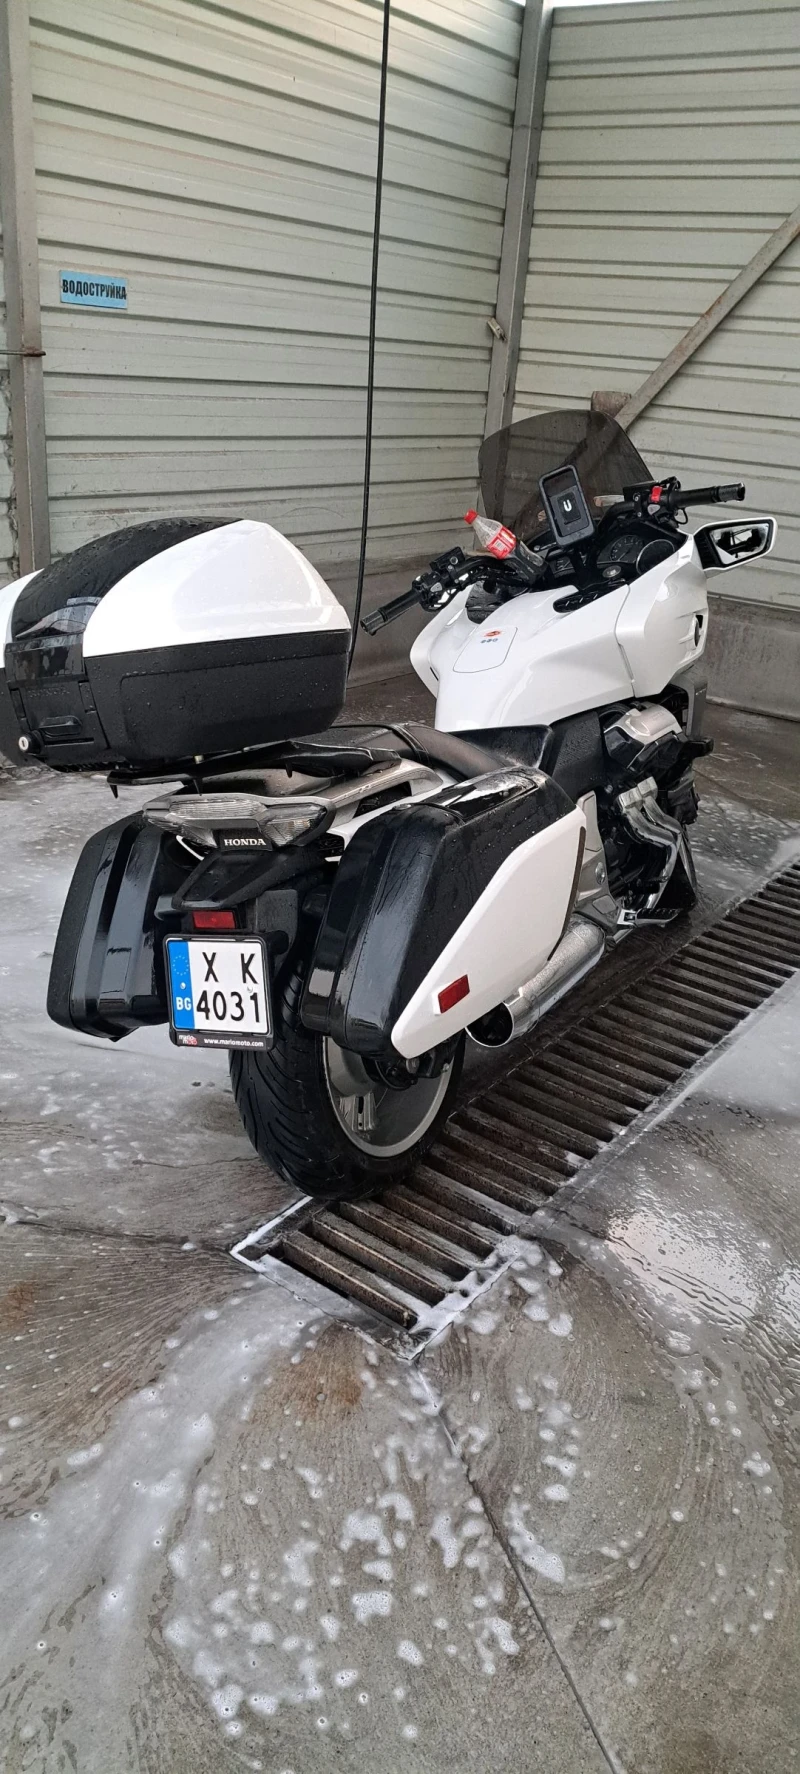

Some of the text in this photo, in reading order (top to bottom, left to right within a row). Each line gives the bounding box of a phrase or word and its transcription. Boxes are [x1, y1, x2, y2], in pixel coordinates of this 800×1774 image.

[62, 279, 127, 300] ВОДОСТРУЙКА
[224, 838, 267, 846] HONDA
[202, 952, 259, 984] X K
[176, 997, 192, 1011] BG
[196, 990, 260, 1023] 4031
[203, 1038, 264, 1047] www.mariomoto.com
